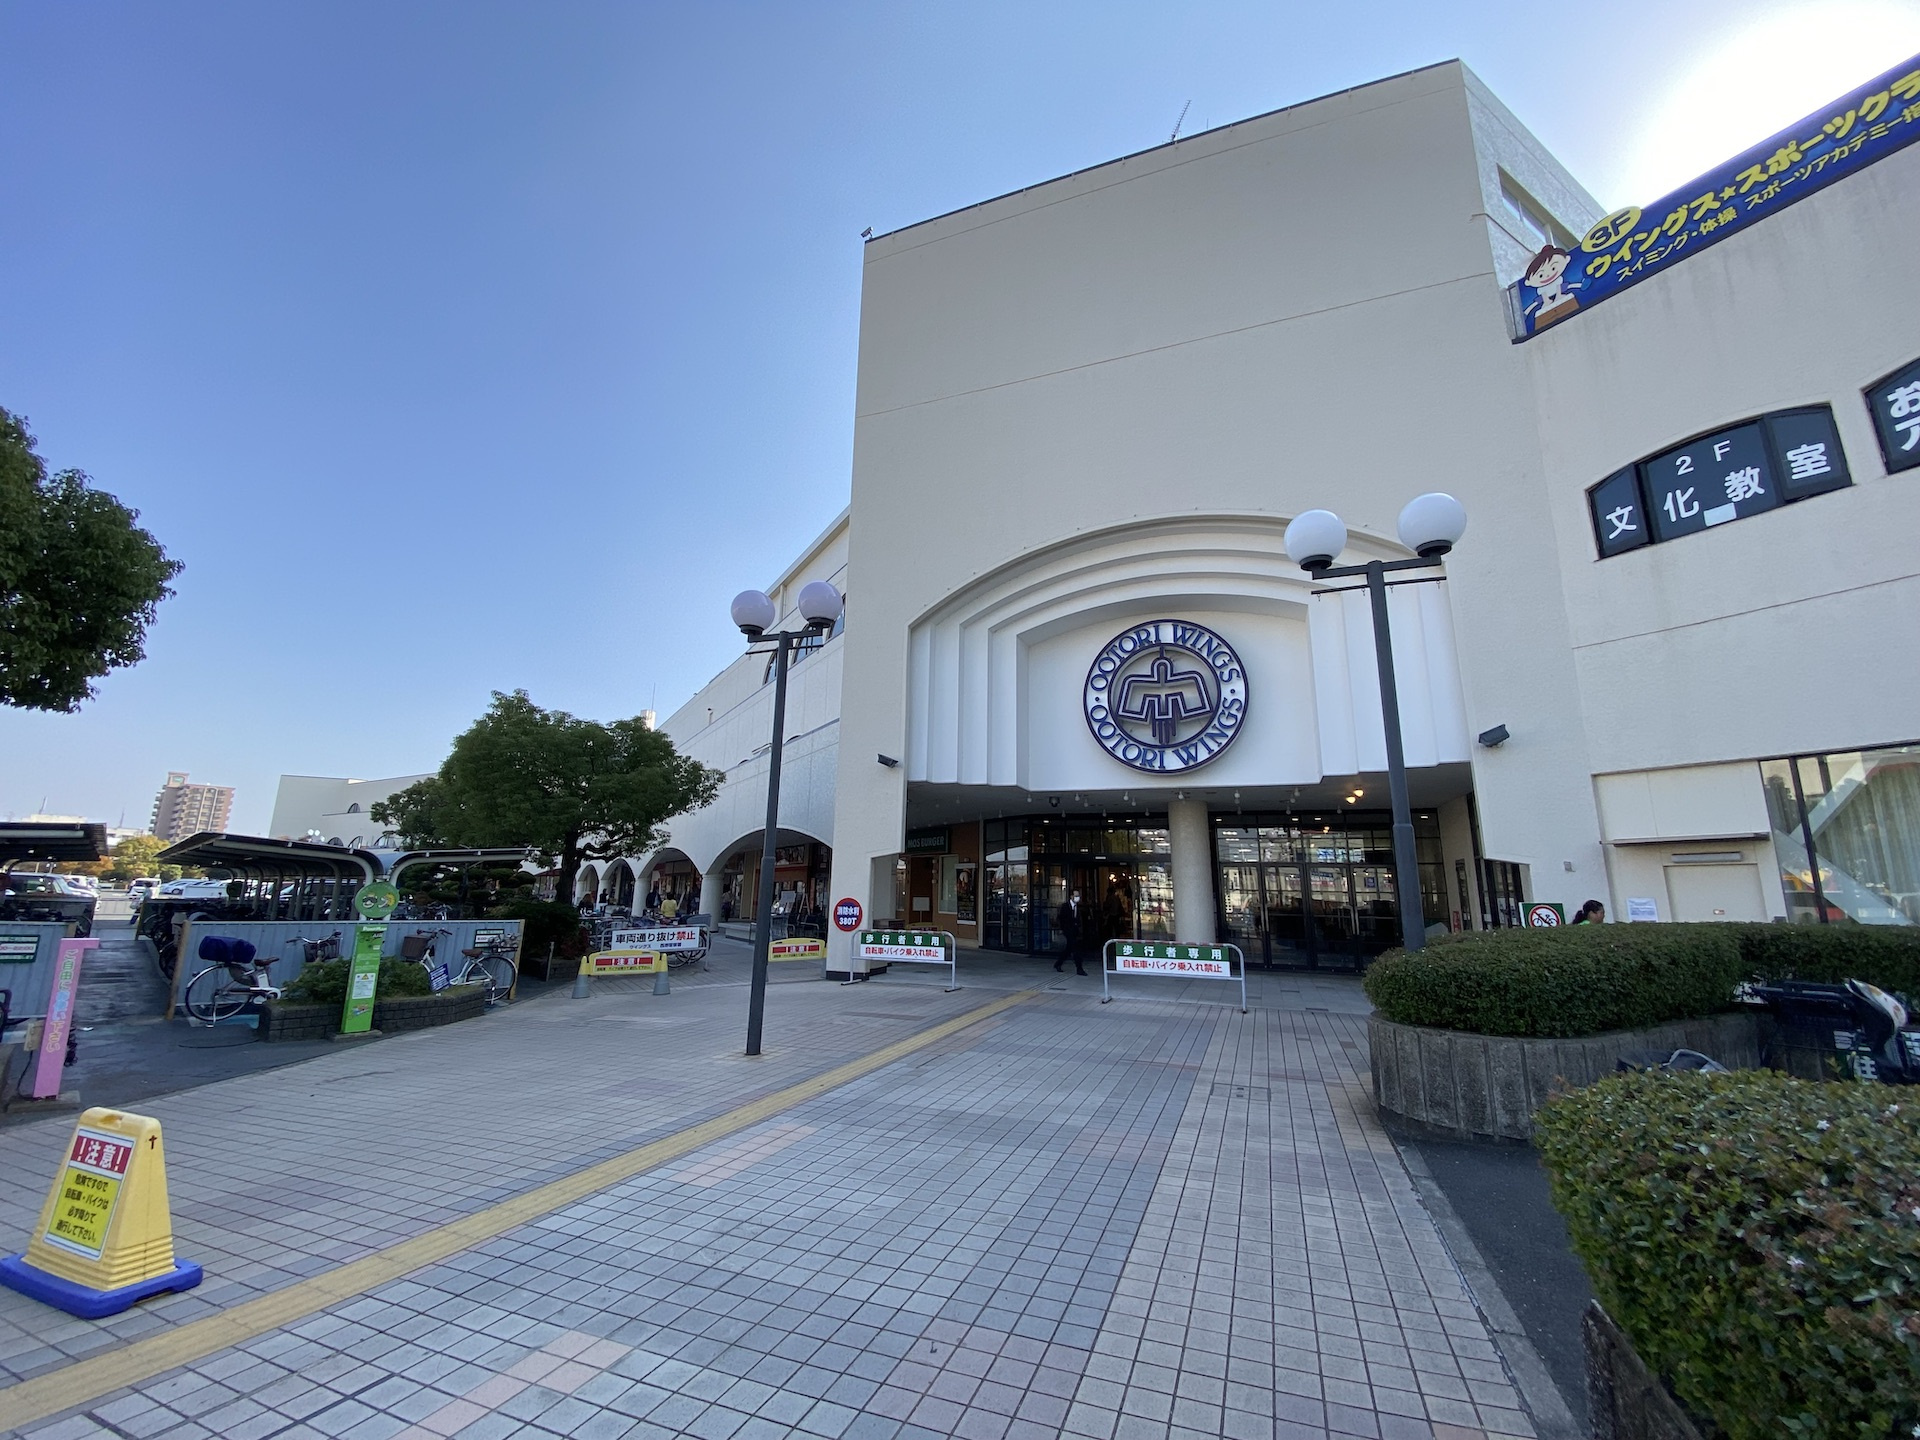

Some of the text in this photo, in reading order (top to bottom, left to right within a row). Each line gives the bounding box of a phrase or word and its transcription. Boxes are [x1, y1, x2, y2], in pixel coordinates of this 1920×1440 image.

[1590, 211, 1632, 248] 3F
[1605, 443, 1831, 539] 文化教室
[1090, 624, 1240, 691] OOTORI WINGS
[1090, 697, 1243, 768] OOTORI WINGS
[921, 836, 944, 847] BURGER
[839, 917, 857, 926] 380T
[615, 931, 695, 943] 車両通り抜け禁止
[865, 934, 940, 946] 歩行者専用
[1122, 945, 1222, 960] 歩行者専用
